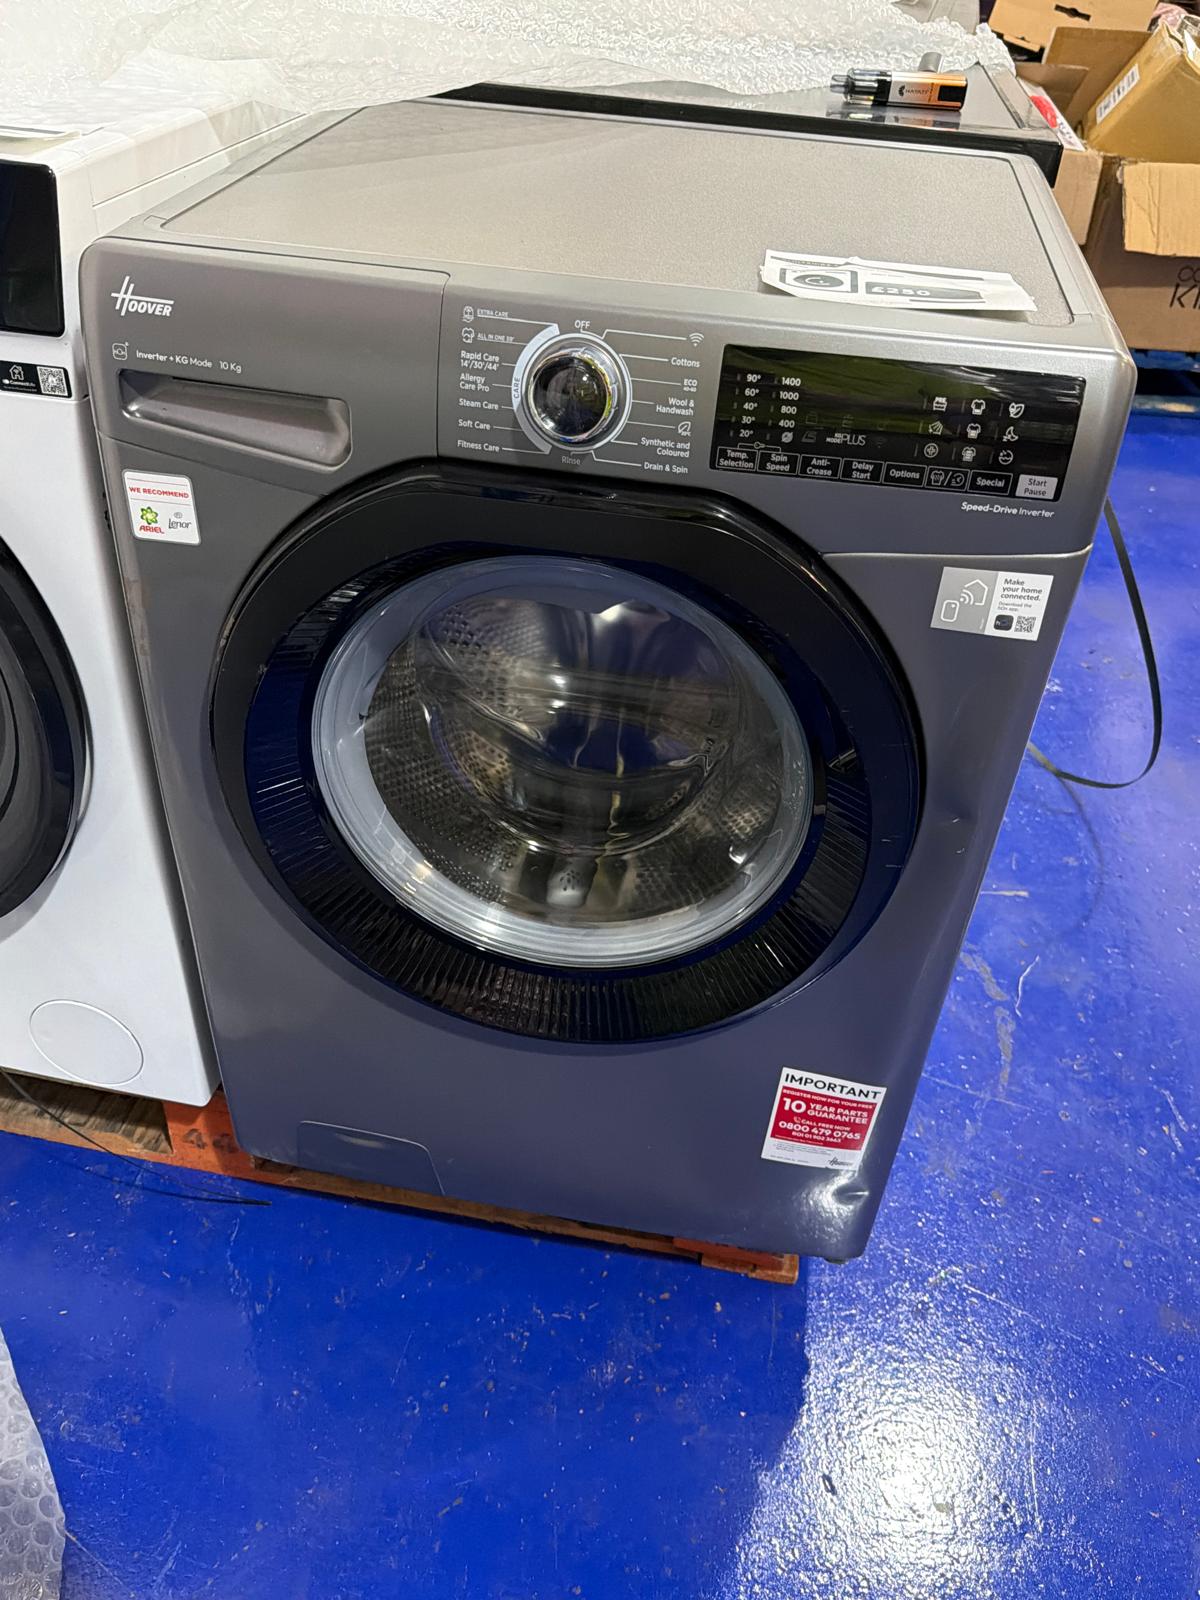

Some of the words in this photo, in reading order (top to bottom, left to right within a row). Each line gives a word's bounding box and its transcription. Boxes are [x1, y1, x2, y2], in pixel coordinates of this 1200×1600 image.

[494, 310, 509, 318] CARE
[574, 319, 591, 329] OFF
[136, 350, 167, 362] Inverter
[175, 355, 188, 365] KG
[189, 358, 212, 368] Mode
[219, 361, 229, 370] 10
[230, 363, 242, 373] Kg
[460, 350, 482, 361] Rapid
[483, 352, 500, 362] Care
[671, 357, 700, 368] Cottons
[459, 373, 485, 384] Allergy
[683, 378, 698, 386] ECO
[746, 373, 761, 383] 90°
[781, 377, 801, 387] 1400
[459, 381, 477, 391] Care
[478, 383, 490, 392] Pro
[513, 376, 521, 399] CARE
[744, 387, 759, 397] 60°
[779, 391, 800, 400] 1000
[458, 398, 481, 408] Steam
[482, 401, 499, 410] Care
[668, 397, 688, 407] Wool
[688, 399, 695, 408] &
[743, 401, 758, 411] 40°
[780, 405, 797, 415] 800
[656, 405, 694, 416] Handwash
[458, 419, 473, 428] Soft
[474, 421, 491, 430] Care
[741, 415, 756, 425] 30°
[778, 418, 795, 428] 400
[738, 428, 754, 438] 20°
[641, 437, 675, 449] Synthetic
[676, 441, 690, 450] and
[842, 433, 867, 446] PLUS
[457, 439, 483, 450] Fitness
[483, 443, 500, 452] Care
[656, 448, 690, 458] Coloured
[726, 449, 749, 459] Temp.
[770, 453, 788, 464] Spin
[561, 456, 581, 465] Rinse
[719, 458, 754, 469] Selection
[810, 457, 830, 467] Anti-
[644, 461, 664, 472] Drain
[664, 464, 671, 472] &
[671, 464, 688, 474] Spin
[765, 462, 790, 472] Speed
[806, 466, 833, 476] Crease
[851, 461, 874, 472] Delay
[851, 470, 871, 479] Start
[888, 469, 920, 480] Options
[975, 476, 1005, 487] Special
[1027, 478, 1048, 487] Start
[142, 488, 190, 499] RECOMMEND
[1023, 487, 1047, 497] Pause
[960, 501, 1018, 515] Speed-Drive
[1018, 506, 1055, 518] Inverter
[168, 518, 192, 530] Lenor
[139, 525, 165, 535] ARIEL
[1003, 578, 1025, 586] Make
[1001, 586, 1020, 594] your
[1020, 586, 1043, 595] home
[1000, 593, 1041, 602] connected.
[785, 1073, 881, 1100] IMPORTANT
[782, 1088, 811, 1100] REGISTER
[827, 1097, 841, 1105] FOR
[782, 1097, 807, 1114] 10
[809, 1102, 836, 1114] YEAR
[837, 1106, 868, 1117] PARTS
[801, 1118, 817, 1127] CALL
[807, 1109, 868, 1125] GUARANTEE
[778, 1120, 810, 1133] 0800
[811, 1126, 832, 1136] 479
[833, 1130, 861, 1140] 0765
